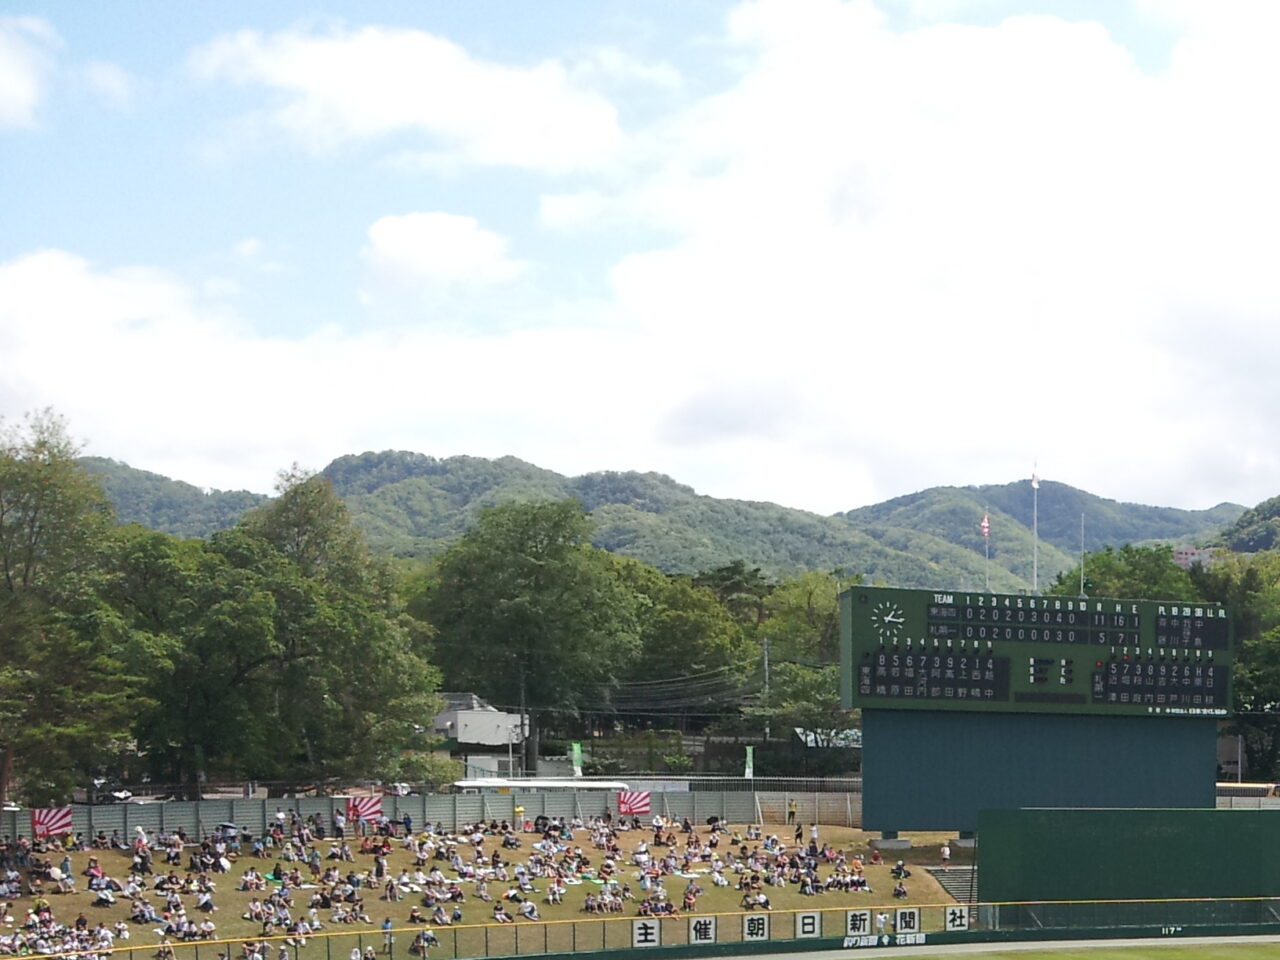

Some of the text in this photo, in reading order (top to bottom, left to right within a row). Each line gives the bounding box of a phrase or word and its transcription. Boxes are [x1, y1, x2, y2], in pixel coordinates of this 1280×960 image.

[934, 594, 953, 603] TEAM
[978, 596, 984, 606] 2
[991, 597, 997, 607] 3
[1004, 598, 1010, 607] 4
[1017, 598, 1023, 608] 5
[1029, 599, 1035, 609] 6
[1042, 599, 1048, 609] 7
[1055, 600, 1061, 610] 8
[1067, 601, 1073, 611] 9
[1096, 602, 1102, 612] R
[1115, 603, 1122, 613] H
[1132, 604, 1137, 614] E
[966, 607, 973, 619] 0
[979, 608, 986, 620] 2
[992, 609, 999, 621] 0
[1005, 610, 1012, 621] 2
[1018, 610, 1025, 622] 0
[1031, 611, 1038, 622] 3
[1043, 612, 1050, 623] 0
[1056, 612, 1062, 623] 4
[1068, 613, 1075, 624] 0
[1095, 614, 1105, 625] 11
[1114, 615, 1125, 627] 16
[966, 626, 973, 638] 0
[979, 626, 986, 638] 0
[992, 627, 999, 639] 2
[1005, 628, 1012, 639] 0
[1018, 629, 1025, 640] 0
[1031, 629, 1037, 641] 0
[1043, 629, 1050, 641] 0
[1056, 630, 1062, 641] 3
[1068, 631, 1075, 642] 0
[1099, 632, 1105, 644] 5
[1118, 633, 1124, 644] 7
[879, 654, 886, 666] 8
[892, 654, 899, 666] 5
[906, 655, 913, 667] 6
[920, 656, 927, 667] 7
[934, 656, 940, 668] 3
[947, 657, 954, 668] 9
[960, 657, 967, 669] 2
[987, 659, 993, 669] 4
[1111, 663, 1213, 677] 5 7 3 8 9 2 6 H 4
[637, 908, 966, 943] 主催朝日新聞社
